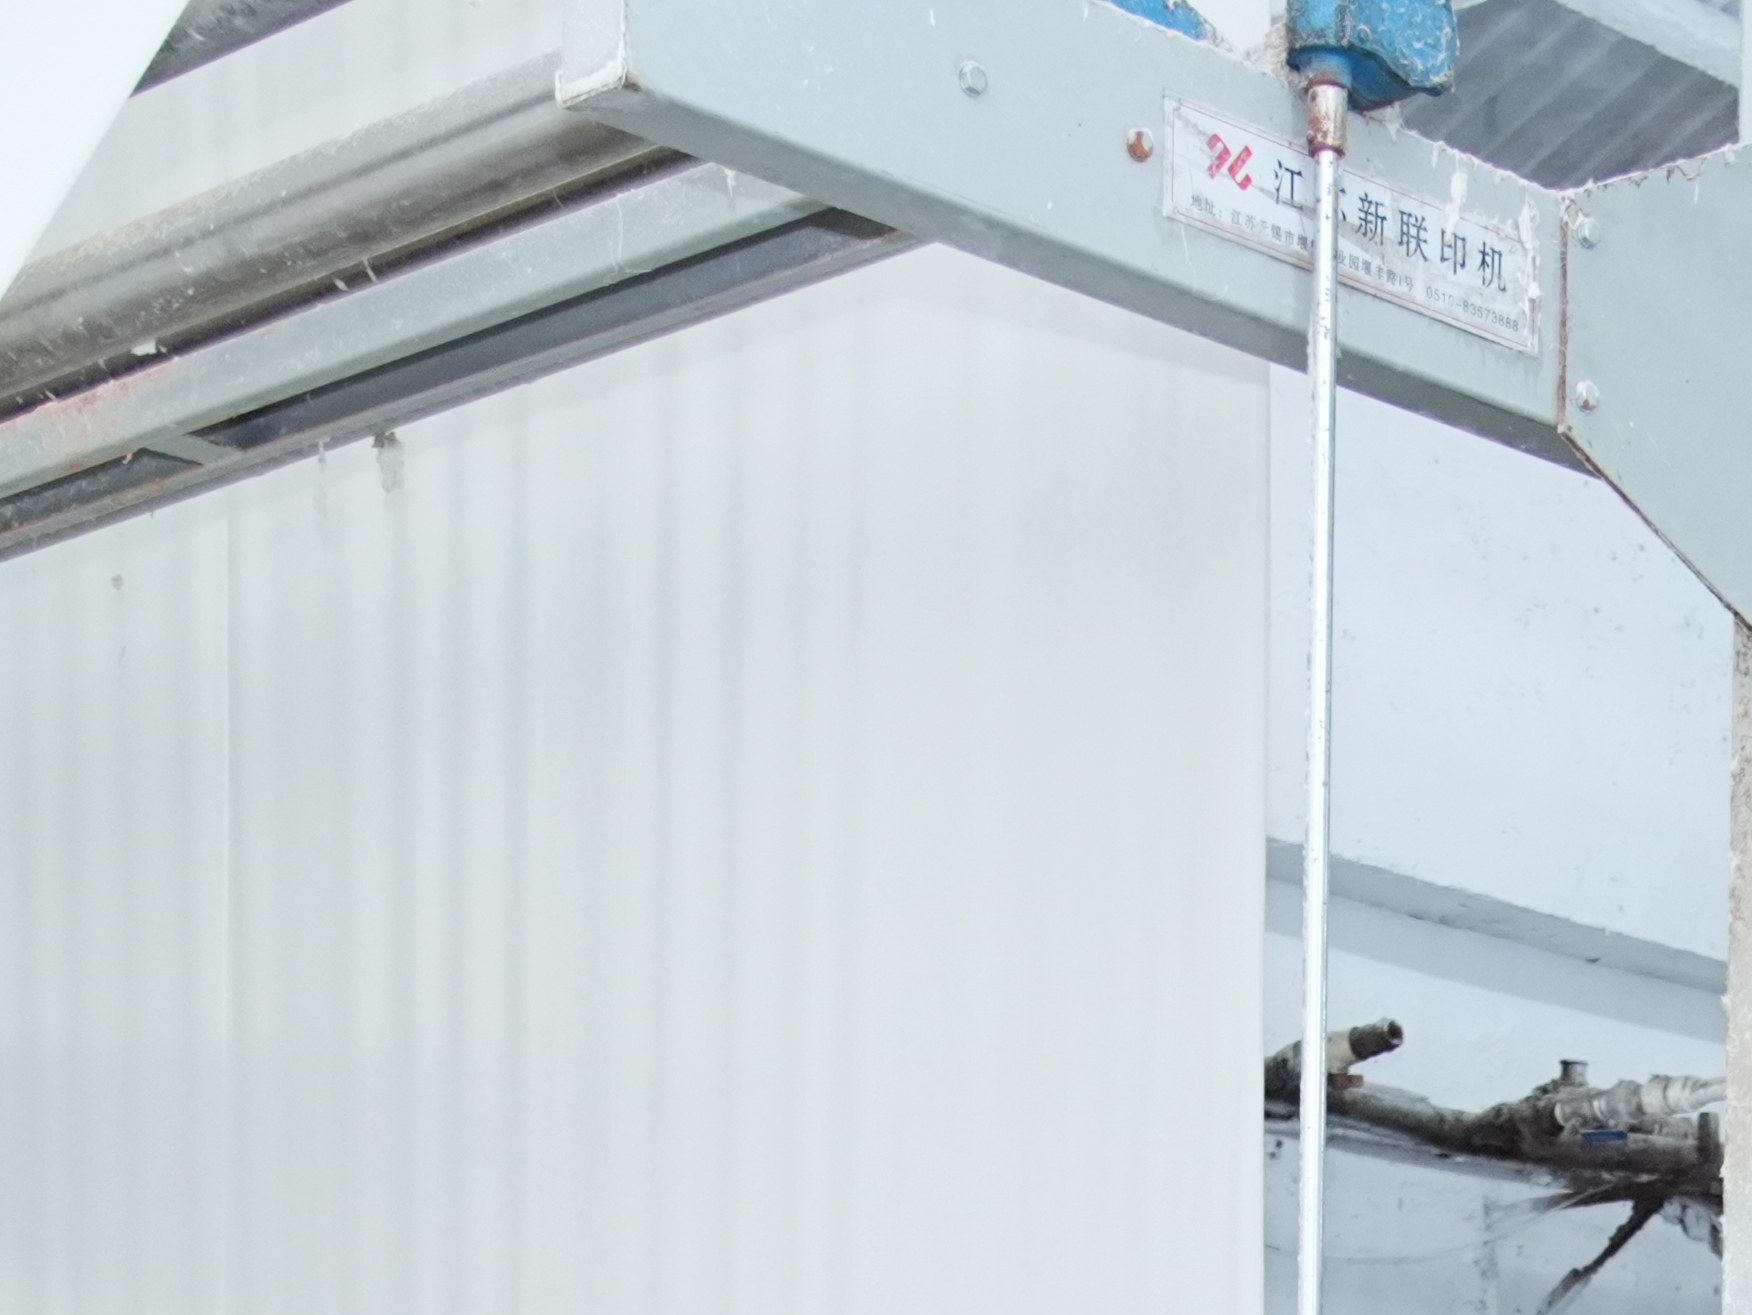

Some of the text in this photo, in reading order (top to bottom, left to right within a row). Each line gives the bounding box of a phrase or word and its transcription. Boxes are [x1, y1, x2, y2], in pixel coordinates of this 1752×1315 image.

[1273, 159, 1507, 293] 江新联印机
